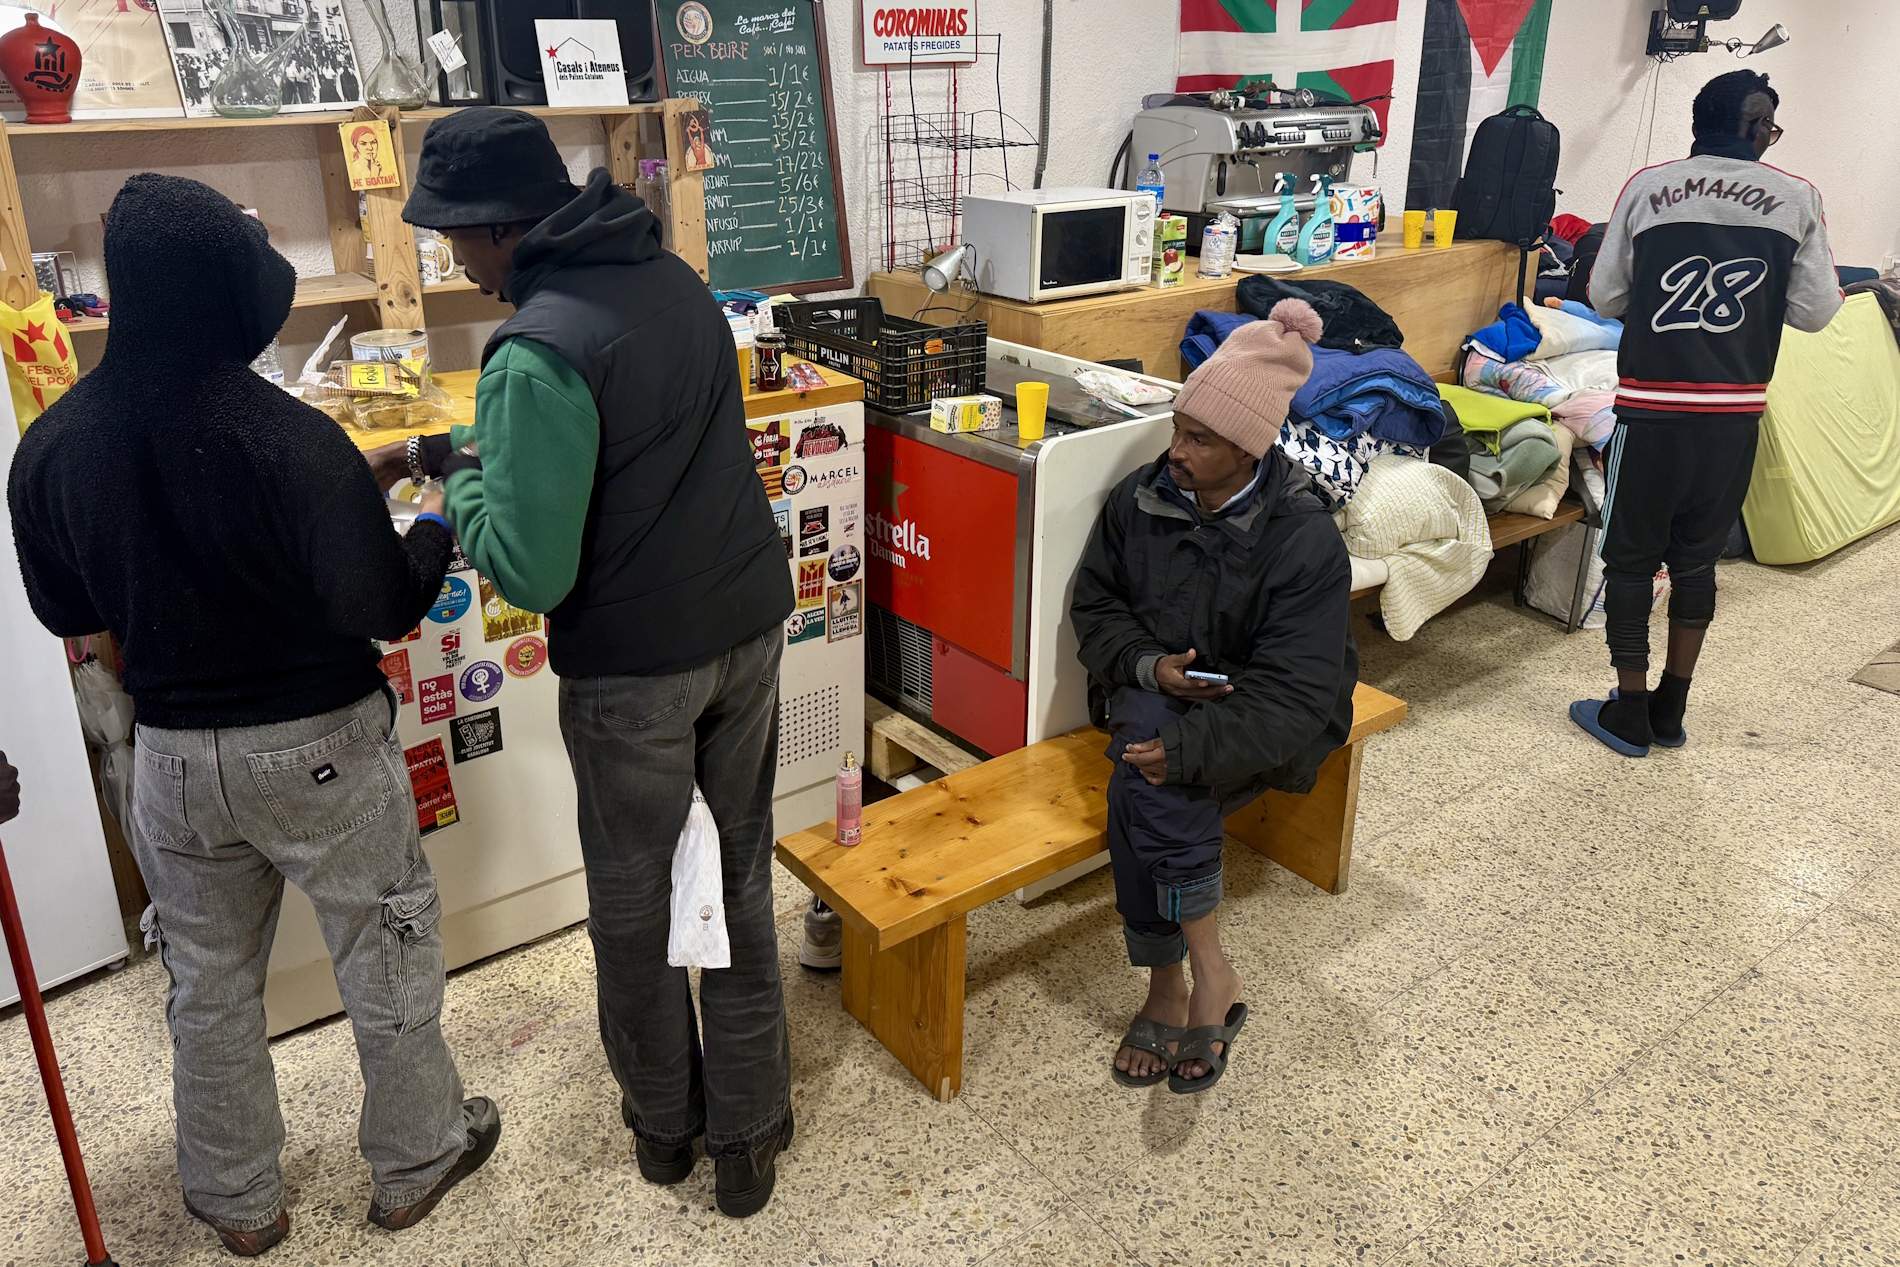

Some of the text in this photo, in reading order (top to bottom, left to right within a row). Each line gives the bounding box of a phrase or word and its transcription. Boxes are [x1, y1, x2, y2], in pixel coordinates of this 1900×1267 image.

[735, 6, 796, 26] La marca del
[873, 8, 968, 37] COROMINAS
[670, 43, 705, 60] PER
[707, 41, 749, 61] BEURE
[883, 40, 961, 51] PATATES FREGIDES
[556, 60, 620, 73] Casals i Ateneus
[676, 68, 709, 83] AIGUA
[352, 178, 363, 189] НЕ
[1648, 177, 1785, 216] McMAHON
[706, 211, 738, 232] NFUSIÓ
[1651, 255, 1768, 333] 28
[820, 347, 849, 365] PILLIN
[27, 364, 69, 375] FESTES
[809, 466, 858, 483] MARCEL
[865, 511, 931, 561] strella
[871, 537, 906, 569] Damm
[440, 632, 460, 652] Sí
[421, 680, 437, 691] no
[423, 689, 453, 703] estàs
[423, 702, 447, 714] sola
[407, 755, 443, 773] CIPATIVA
[418, 792, 452, 810] carrer és
